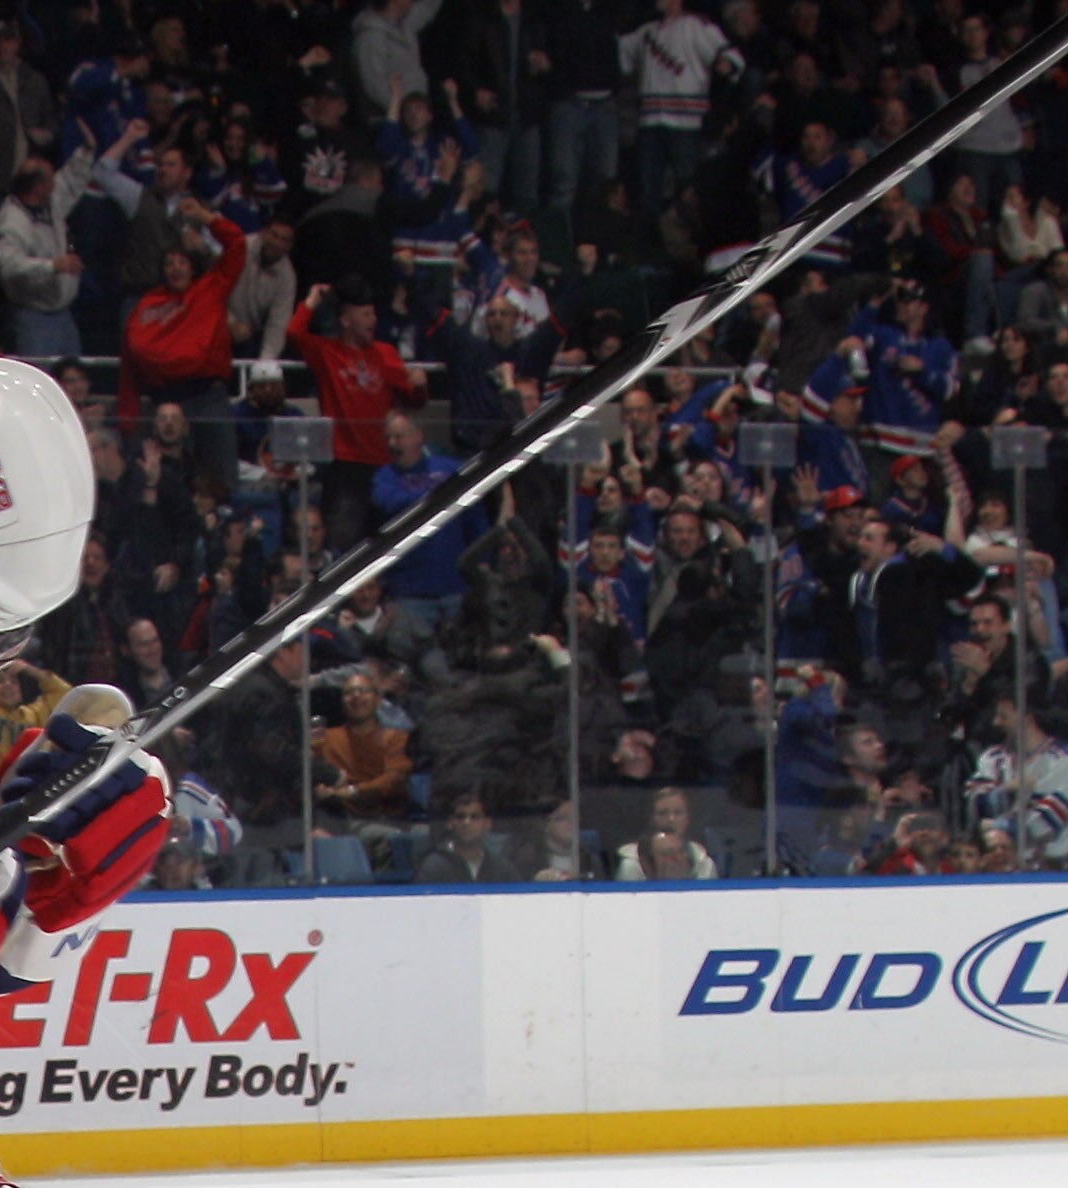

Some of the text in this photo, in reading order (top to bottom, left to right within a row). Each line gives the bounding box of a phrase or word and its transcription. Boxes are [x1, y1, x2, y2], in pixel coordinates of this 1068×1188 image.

[678, 940, 1068, 1016] BUD L
[39, 1059, 197, 1110] Every
[204, 1053, 347, 1106] Body.
